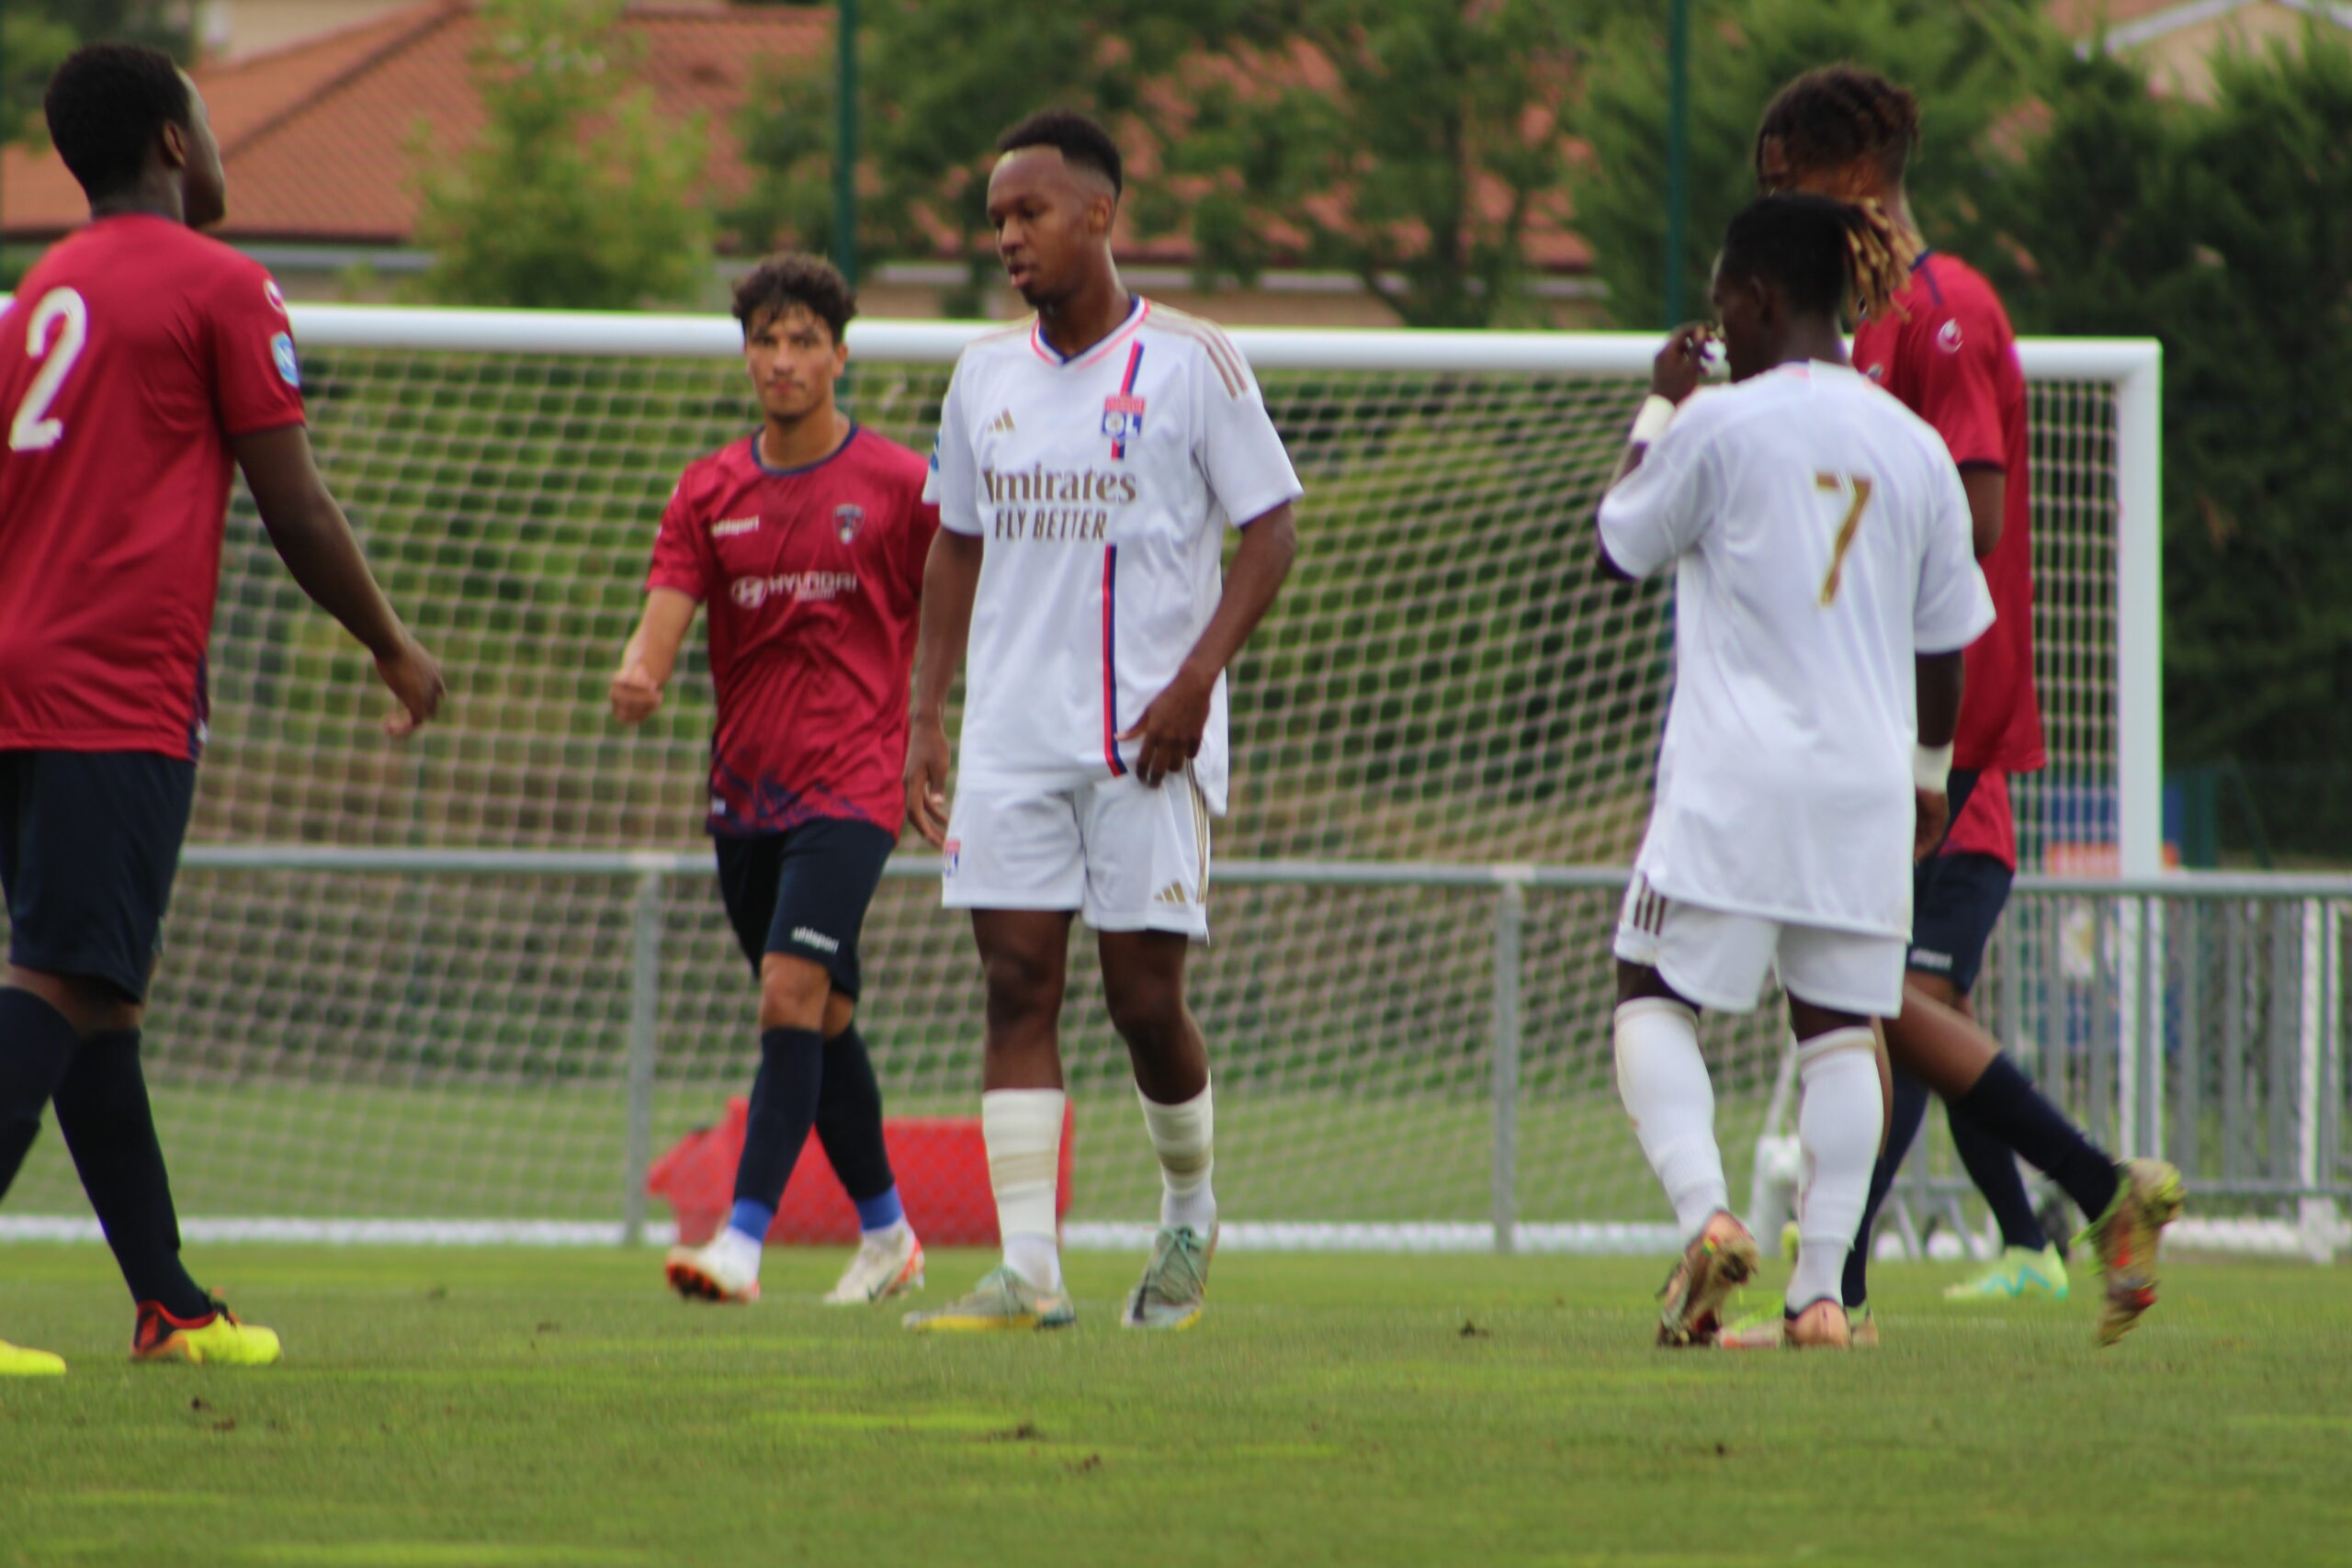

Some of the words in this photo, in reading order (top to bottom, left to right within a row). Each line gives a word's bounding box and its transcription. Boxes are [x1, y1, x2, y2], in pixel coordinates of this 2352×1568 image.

[8, 286, 86, 451] 2
[995, 509, 1026, 539] FLY
[1032, 509, 1108, 539] BETTER
[1815, 471, 1872, 606] 7
